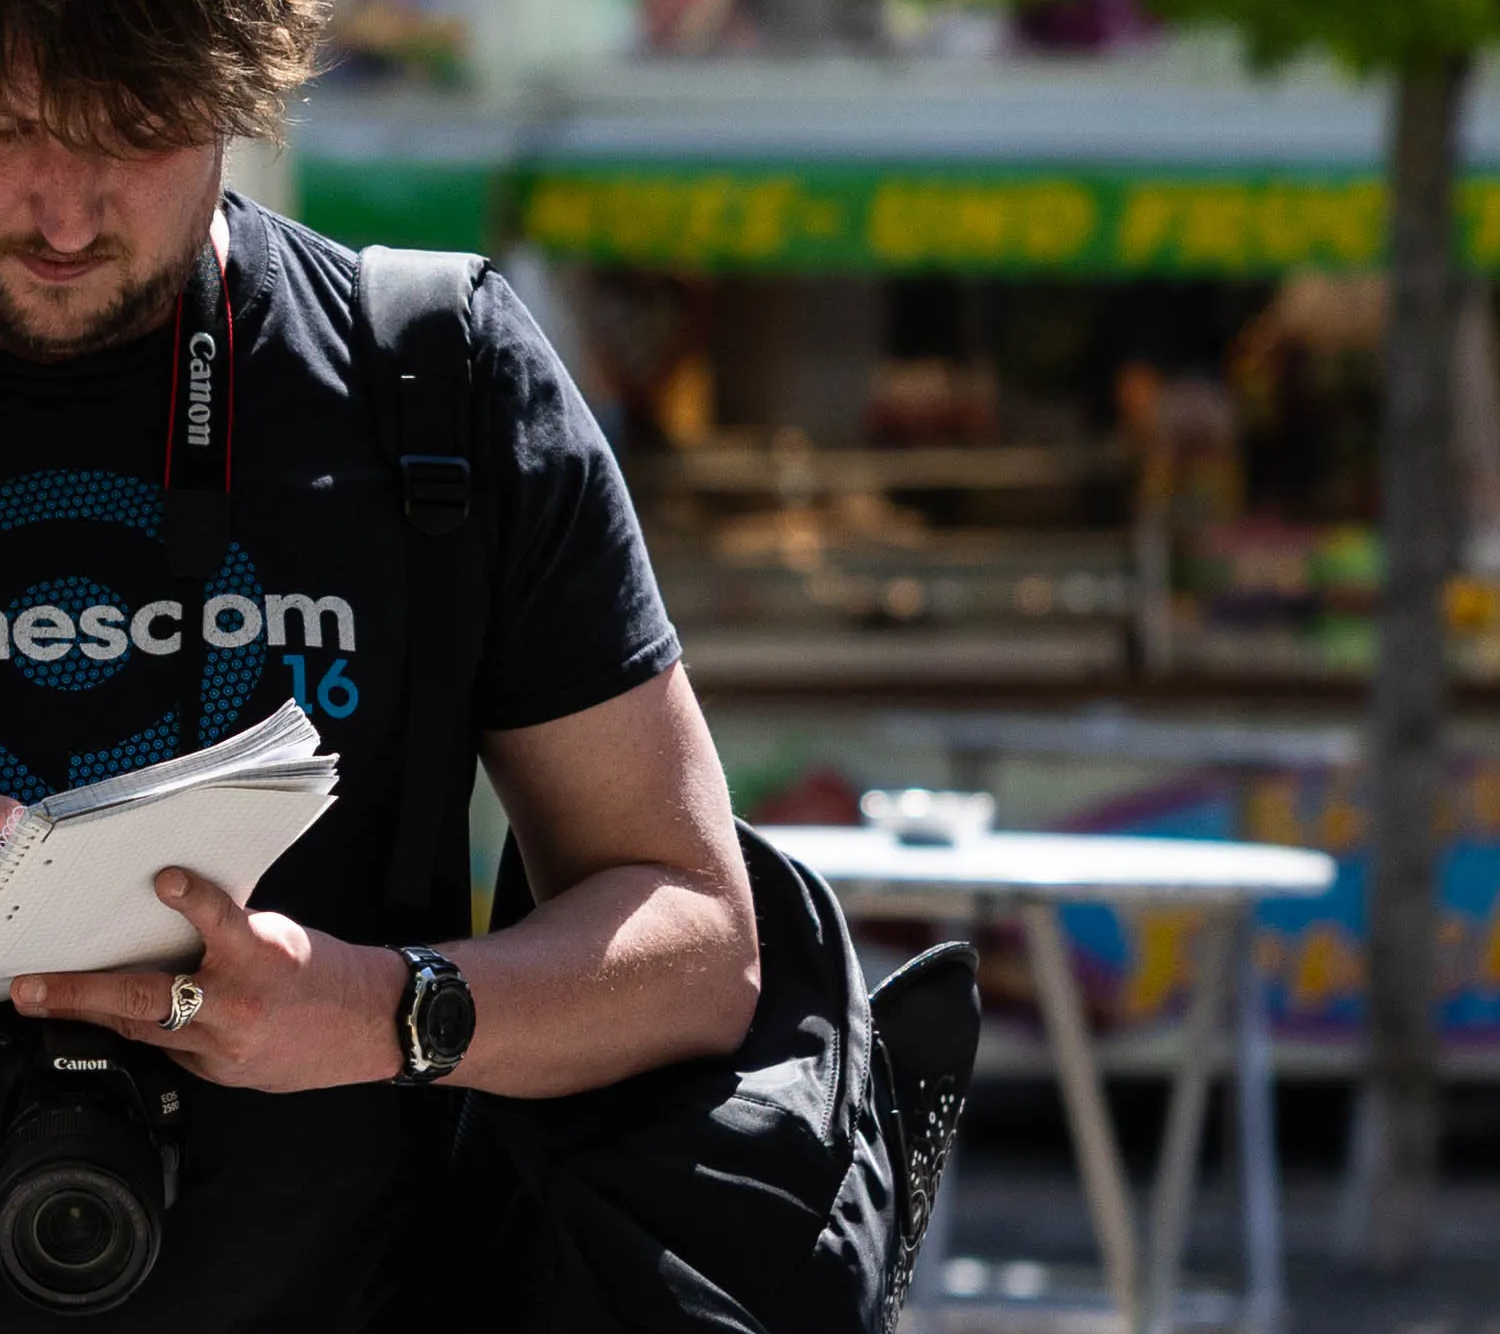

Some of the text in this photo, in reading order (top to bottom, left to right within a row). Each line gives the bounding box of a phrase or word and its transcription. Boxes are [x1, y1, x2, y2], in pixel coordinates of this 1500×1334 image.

[187, 331, 217, 447] Canon
[282, 653, 360, 720] 16
[53, 1057, 108, 1070] Canon
[160, 1091, 179, 1103] EOS
